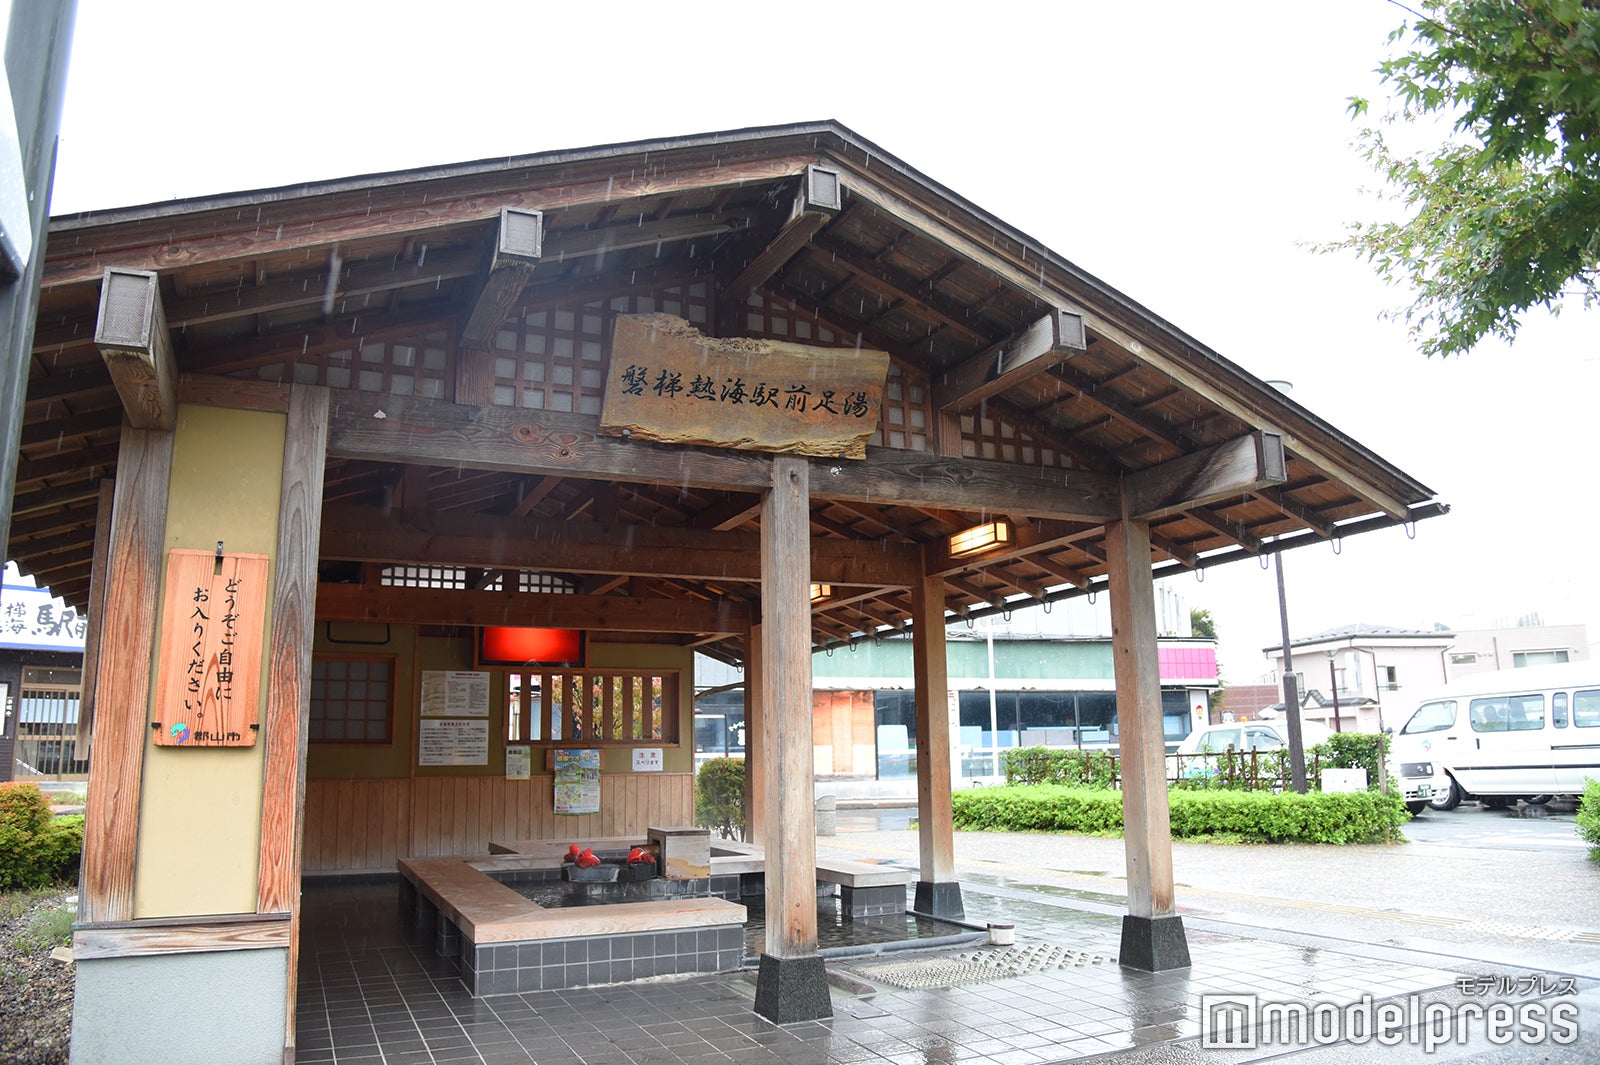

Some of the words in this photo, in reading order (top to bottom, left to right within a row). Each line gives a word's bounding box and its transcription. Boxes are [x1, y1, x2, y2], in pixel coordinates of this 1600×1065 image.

[621, 364, 870, 418] 磐梯熱海駅前足湯
[184, 587, 210, 719] お入りください。
[215, 578, 242, 700] どうぞご自由に
[193, 731, 241, 742] 郡山市
